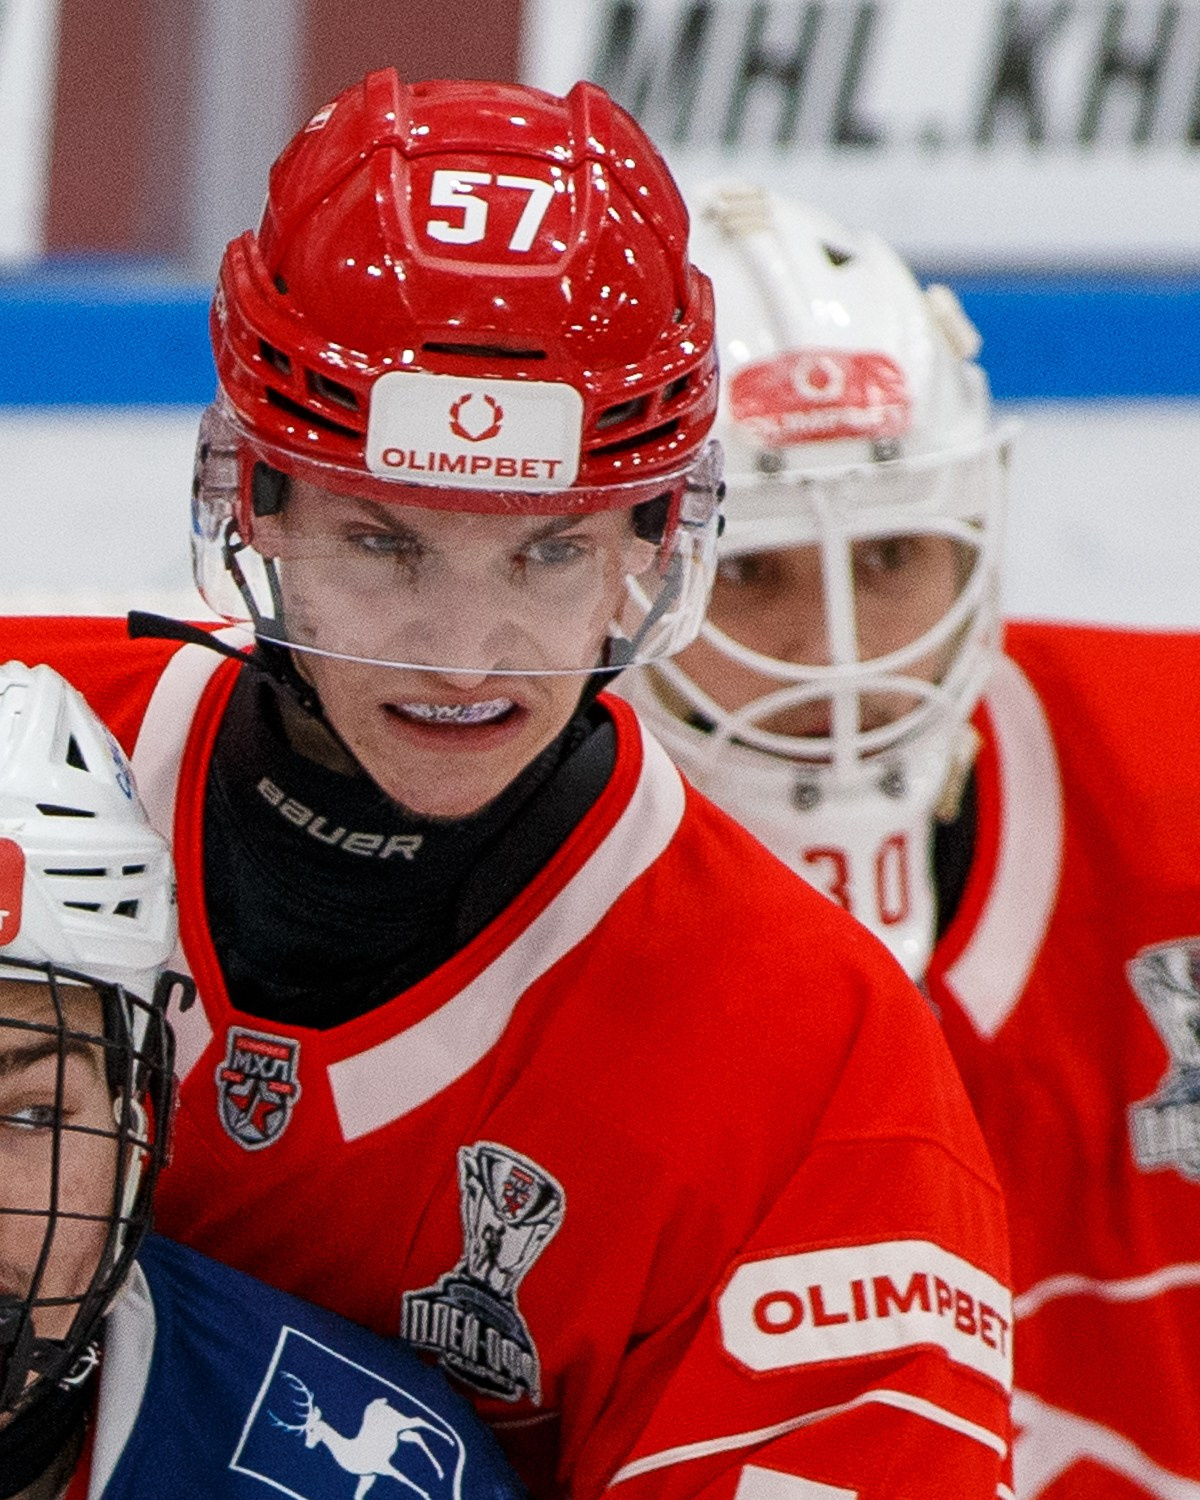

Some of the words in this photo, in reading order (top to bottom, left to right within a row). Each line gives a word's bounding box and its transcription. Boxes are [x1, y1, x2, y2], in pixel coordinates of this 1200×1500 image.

[593, 0, 1200, 150] MHL.KH
[427, 169, 555, 252] 57
[382, 448, 562, 479] OLIMPBET
[753, 1272, 1008, 1357] OLIMPBET
